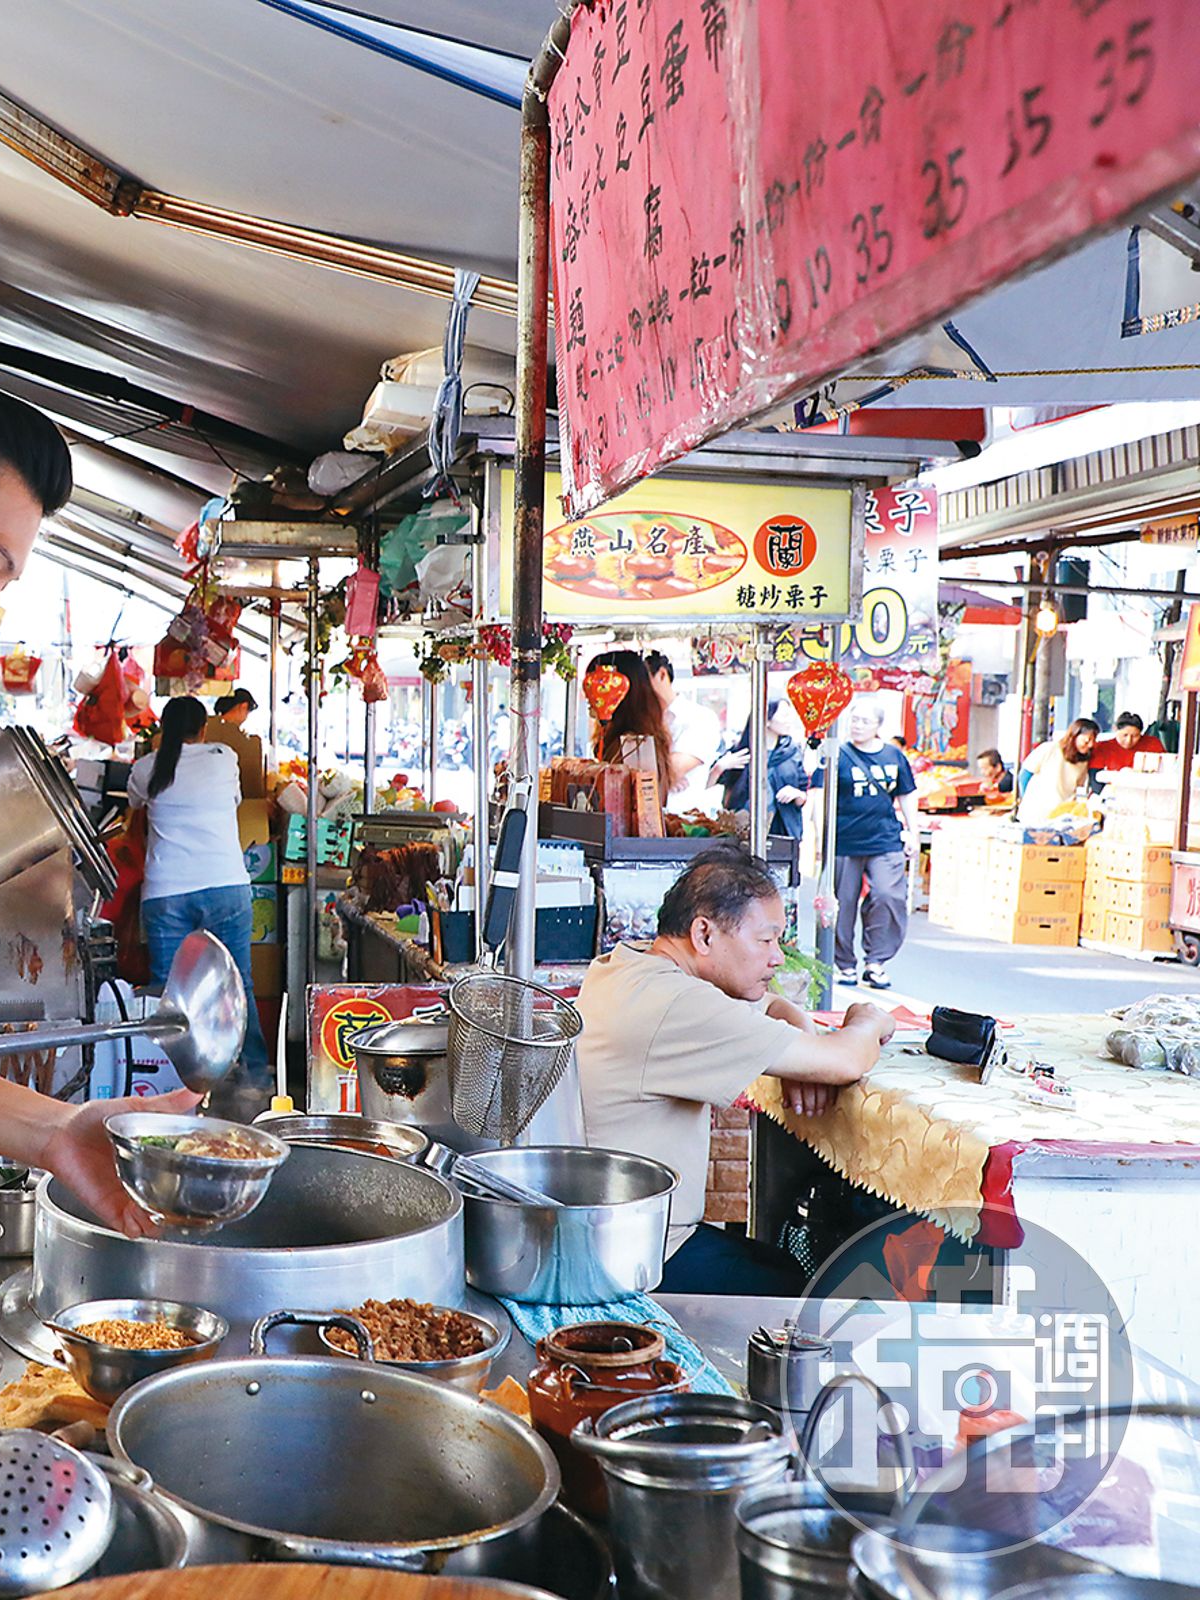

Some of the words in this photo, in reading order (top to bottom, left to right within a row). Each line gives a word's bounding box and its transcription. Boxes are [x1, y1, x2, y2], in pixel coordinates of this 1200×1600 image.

[920, 147, 969, 239] 35
[851, 204, 893, 284] 35
[570, 524, 709, 557] 燕山名產
[735, 582, 829, 610] 糖炒栗子
